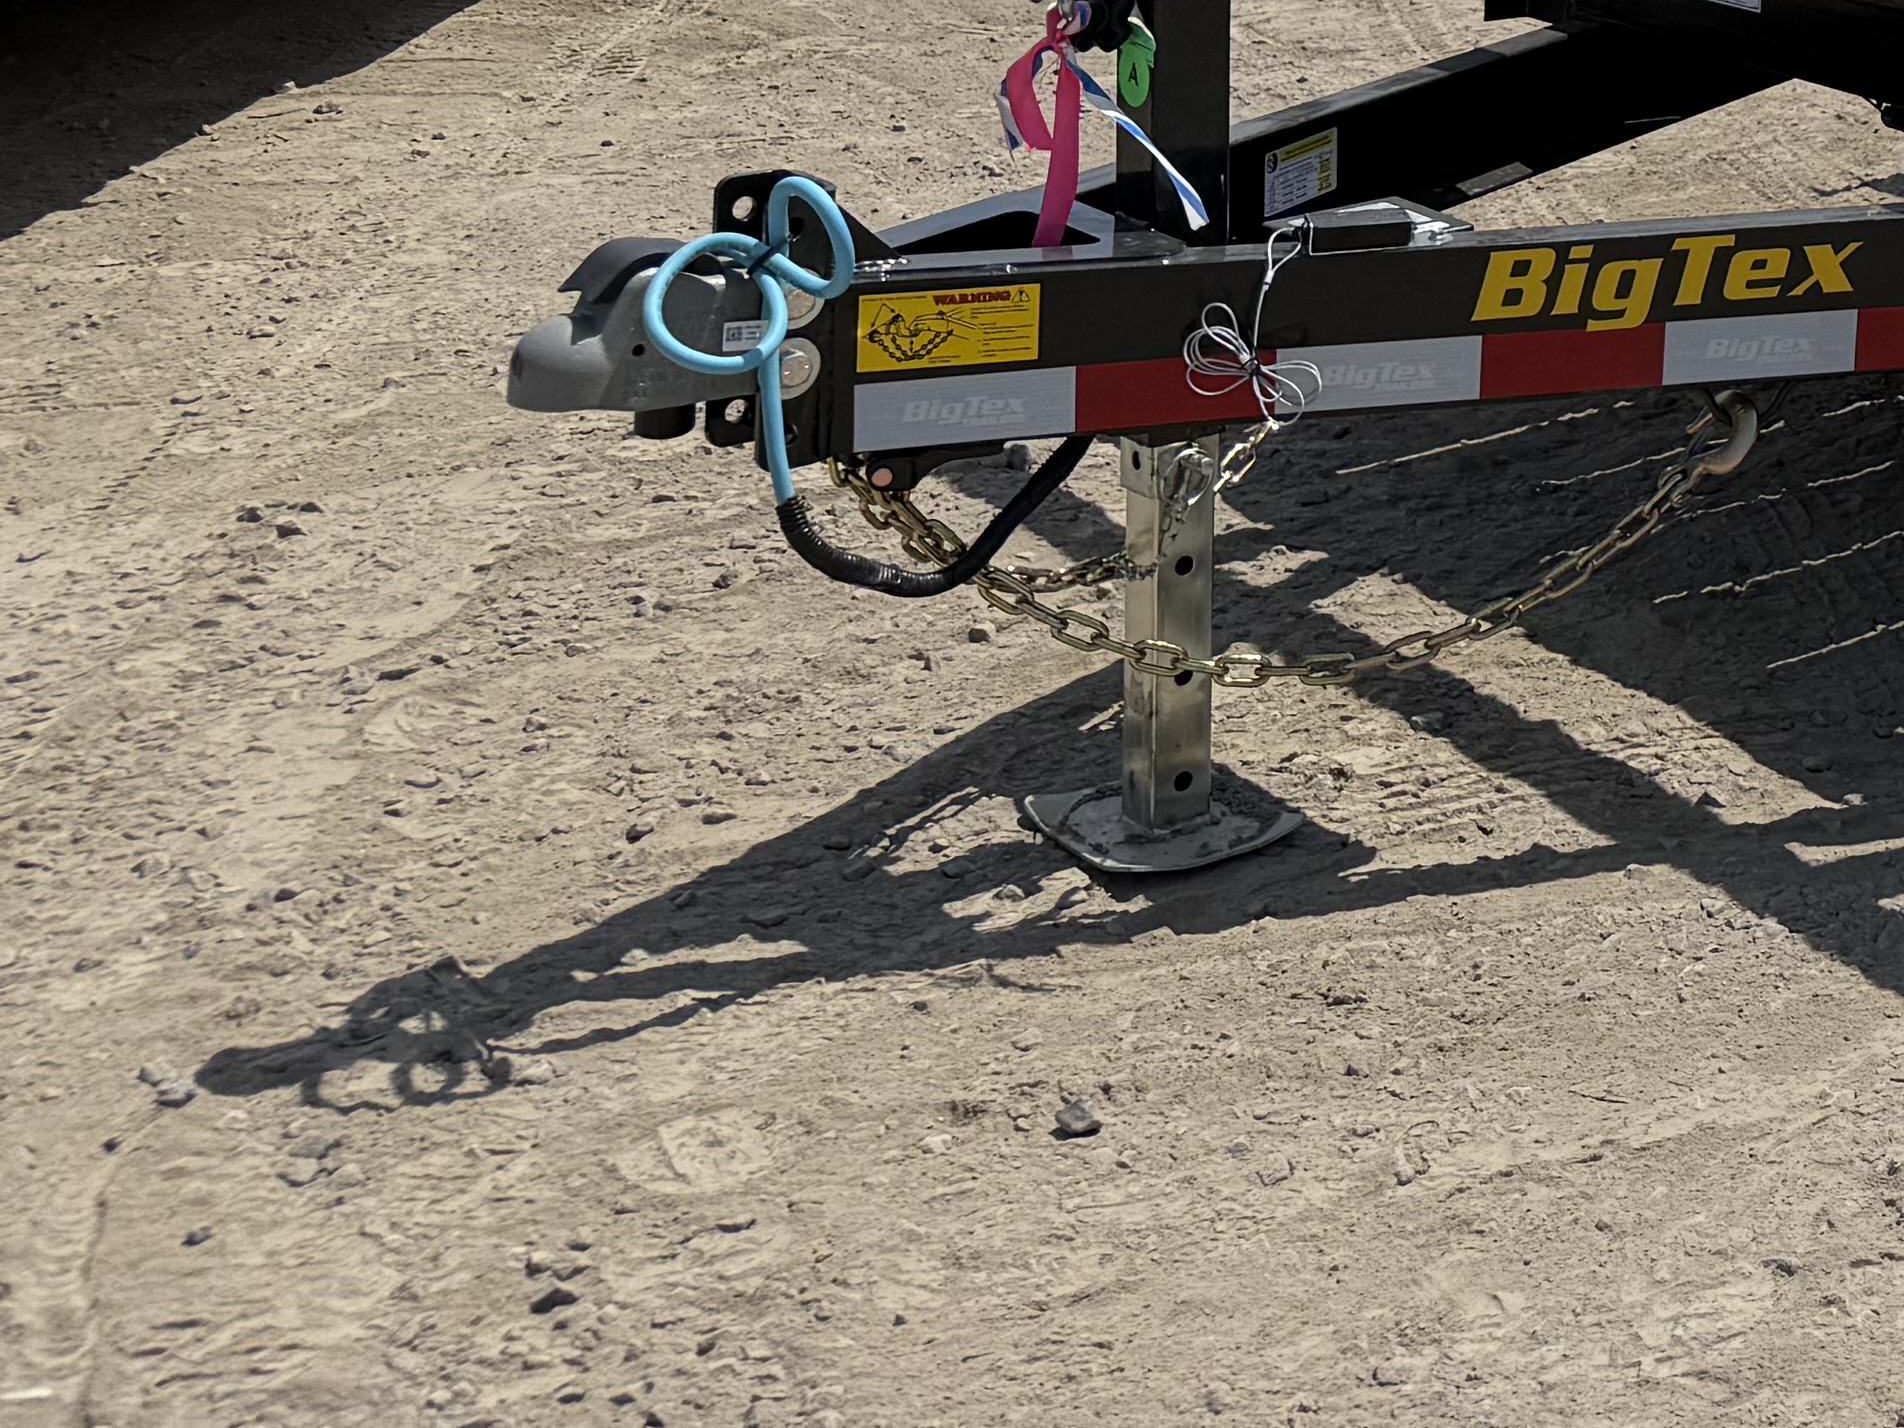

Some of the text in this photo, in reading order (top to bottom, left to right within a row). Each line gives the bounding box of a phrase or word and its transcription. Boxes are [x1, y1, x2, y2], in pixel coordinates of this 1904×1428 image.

[1128, 61, 1139, 87] A
[1471, 234, 1864, 332] BigTex
[932, 290, 1011, 306] WARNING
[903, 396, 1027, 425] BigTex
